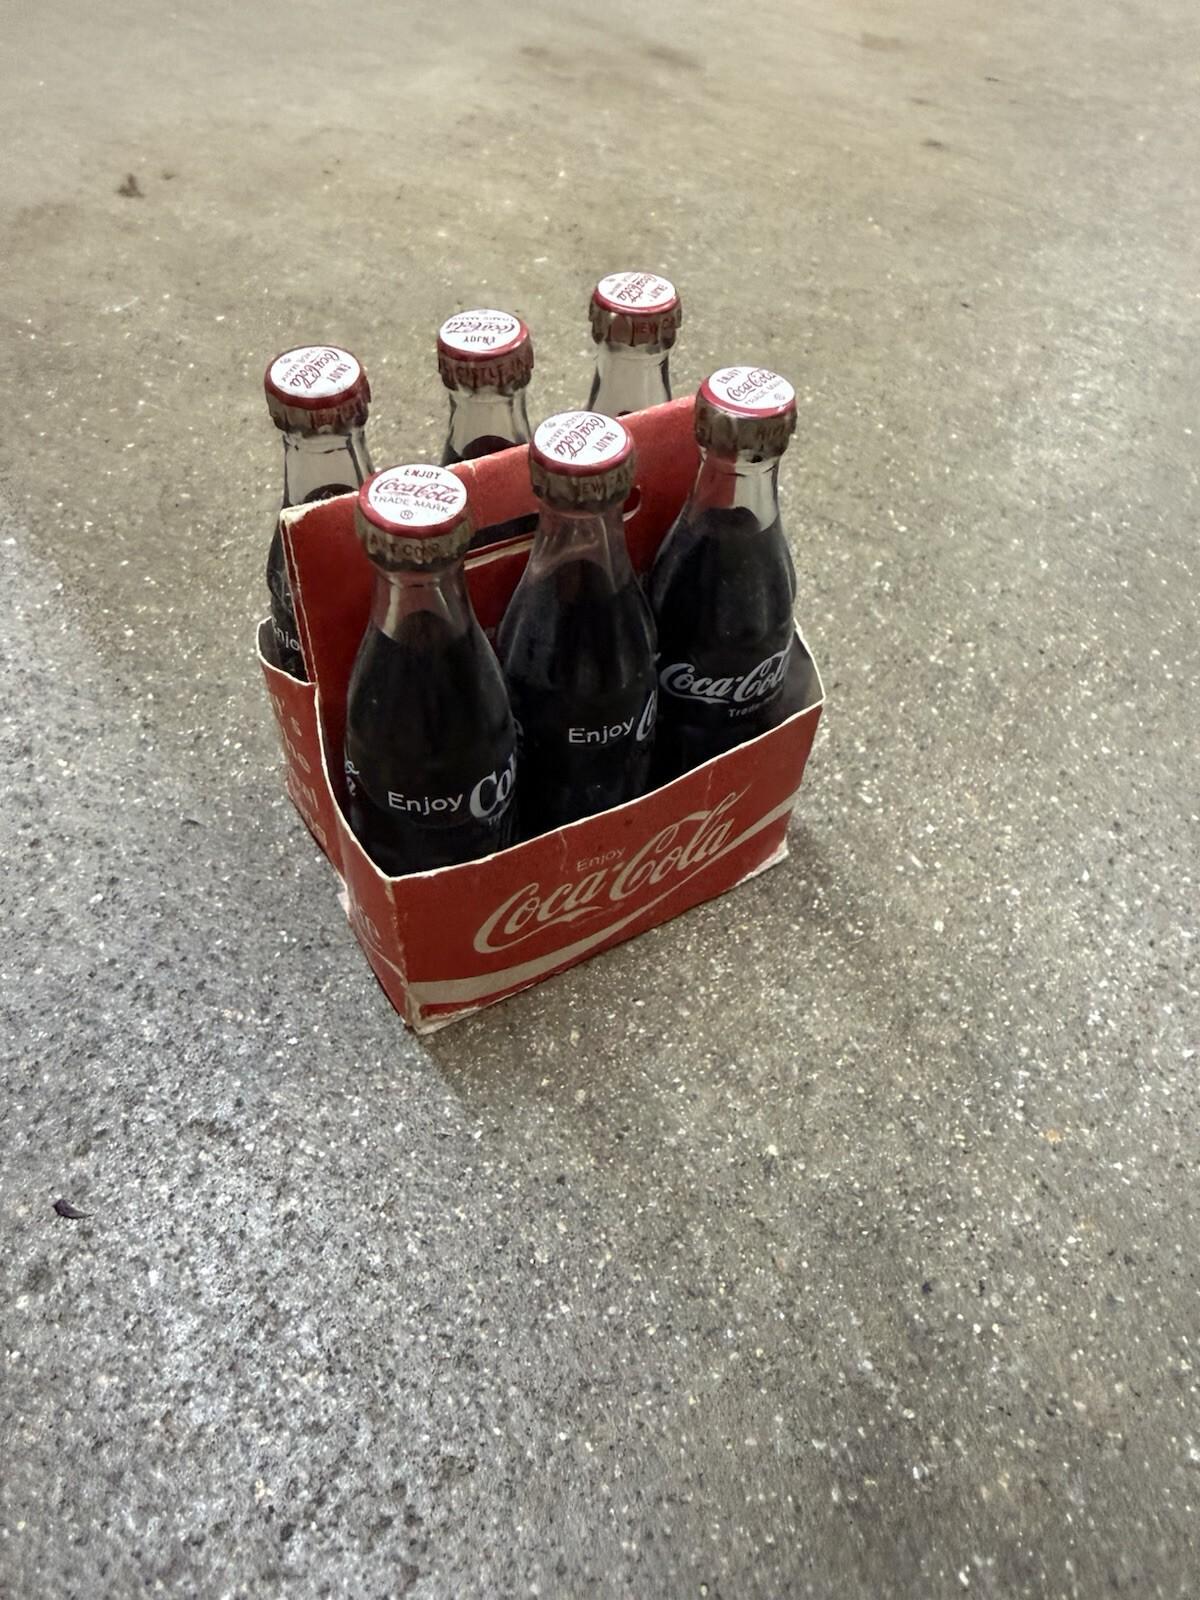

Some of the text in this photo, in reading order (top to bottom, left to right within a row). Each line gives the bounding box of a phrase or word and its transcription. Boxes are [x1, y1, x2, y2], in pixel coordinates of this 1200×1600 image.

[463, 335, 496, 346] ENJOY
[592, 431, 619, 452] ENJOY
[404, 468, 441, 480] ENJOY
[373, 495, 449, 513] TRADE MARK
[568, 716, 634, 744] Enjoy
[387, 791, 463, 816] Enjoy
[473, 786, 750, 954] Coca-Cola
[576, 846, 625, 873] Enjoy
